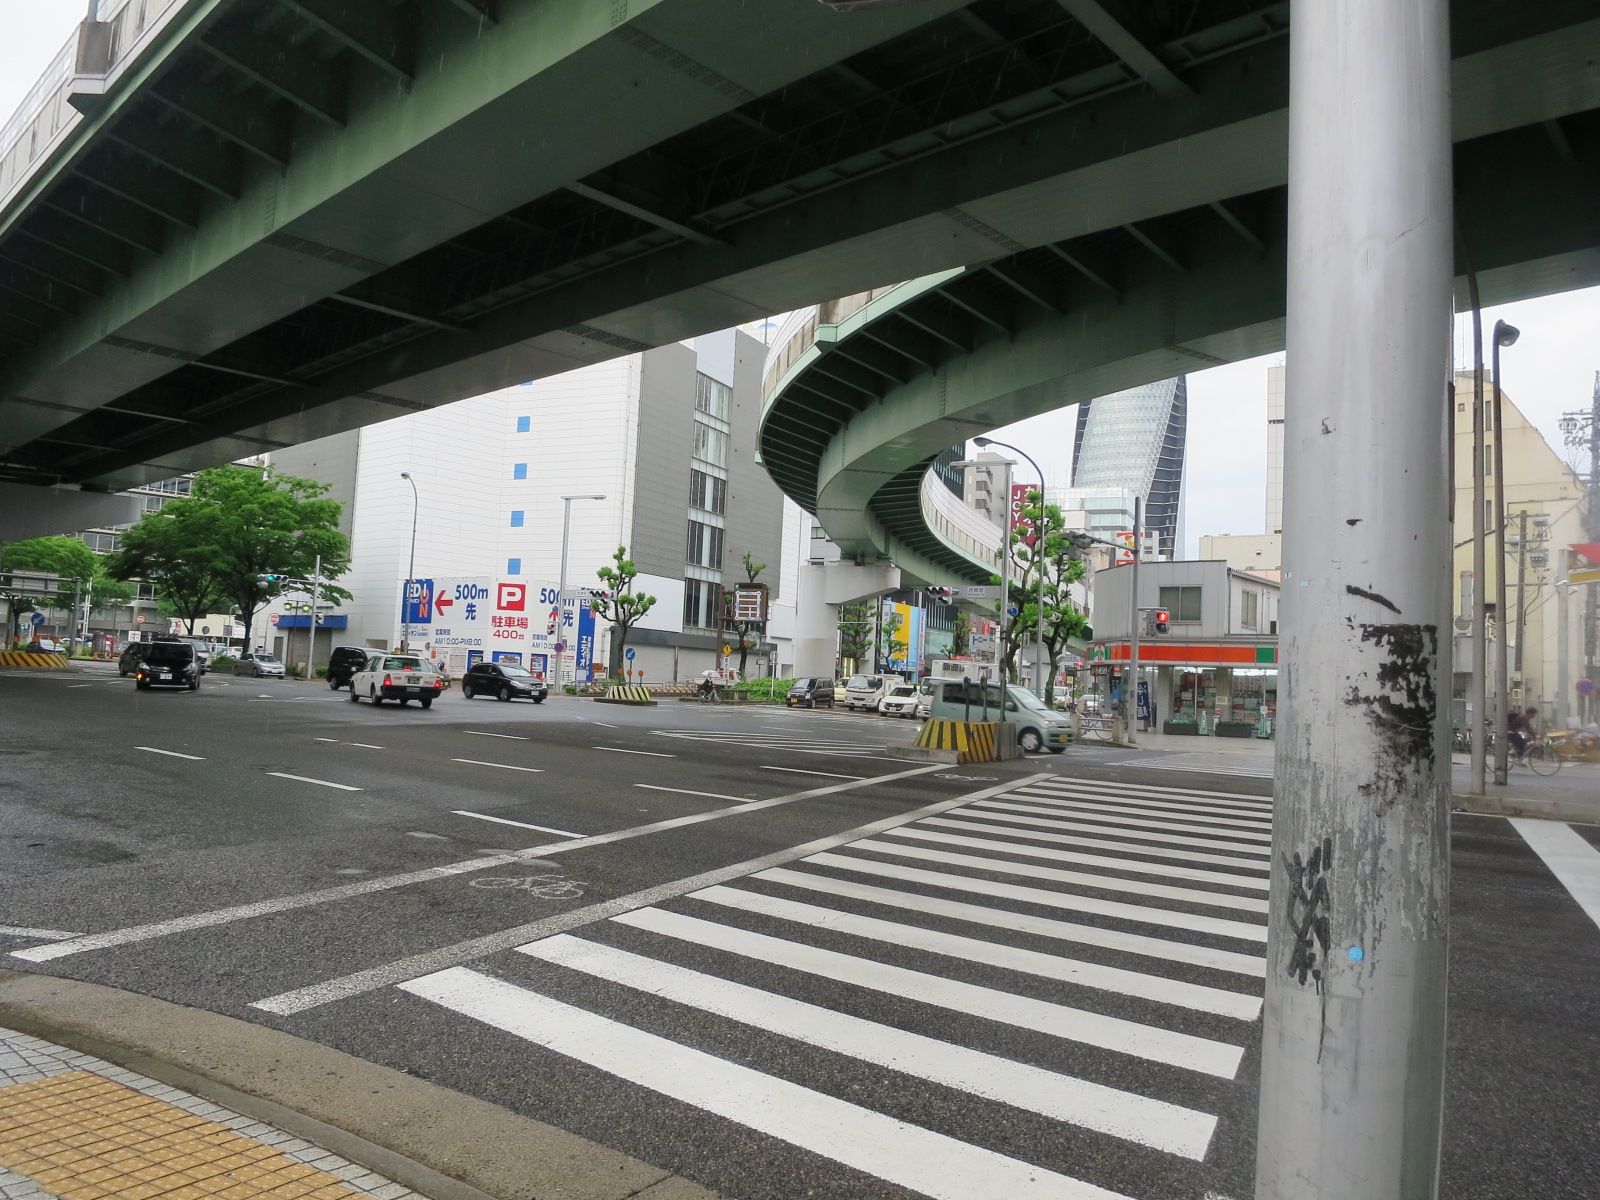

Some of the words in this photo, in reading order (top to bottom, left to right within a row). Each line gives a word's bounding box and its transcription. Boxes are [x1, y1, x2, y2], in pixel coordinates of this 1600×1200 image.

[455, 584, 488, 600] 500m
[500, 587, 522, 607] P
[465, 602, 477, 621] 先
[491, 615, 528, 630] 駐車場
